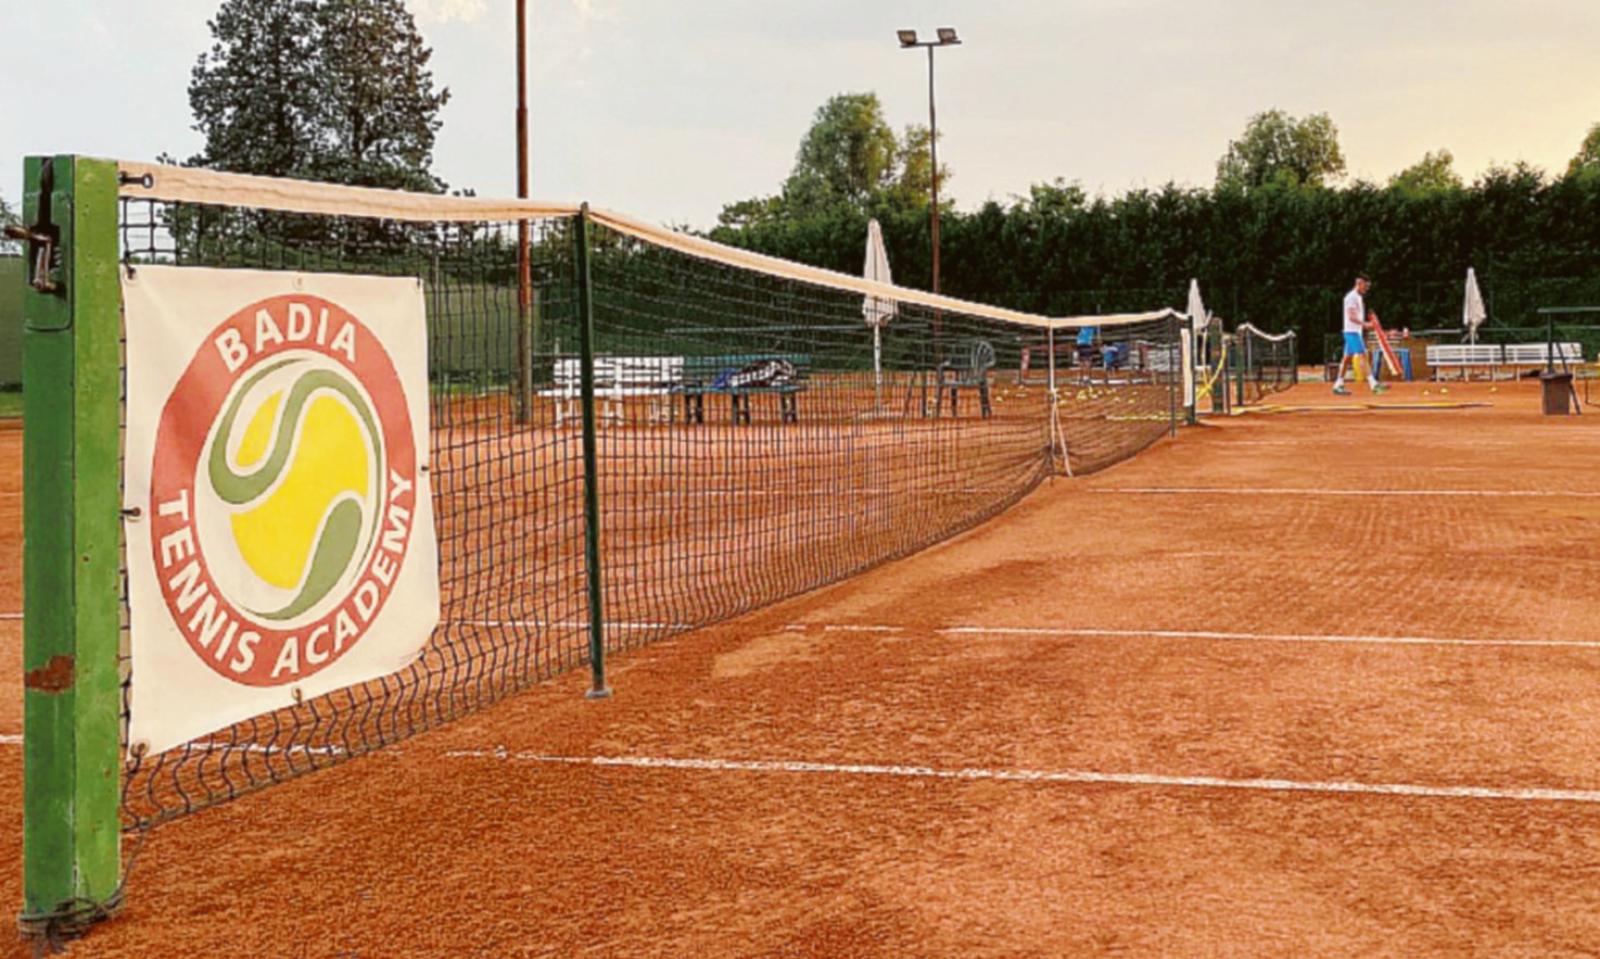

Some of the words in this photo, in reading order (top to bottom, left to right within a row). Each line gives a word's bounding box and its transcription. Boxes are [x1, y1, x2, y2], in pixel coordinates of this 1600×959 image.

[214, 303, 356, 372] BADIA
[158, 489, 260, 672] TENNIS
[271, 470, 413, 678] ACADEMY
